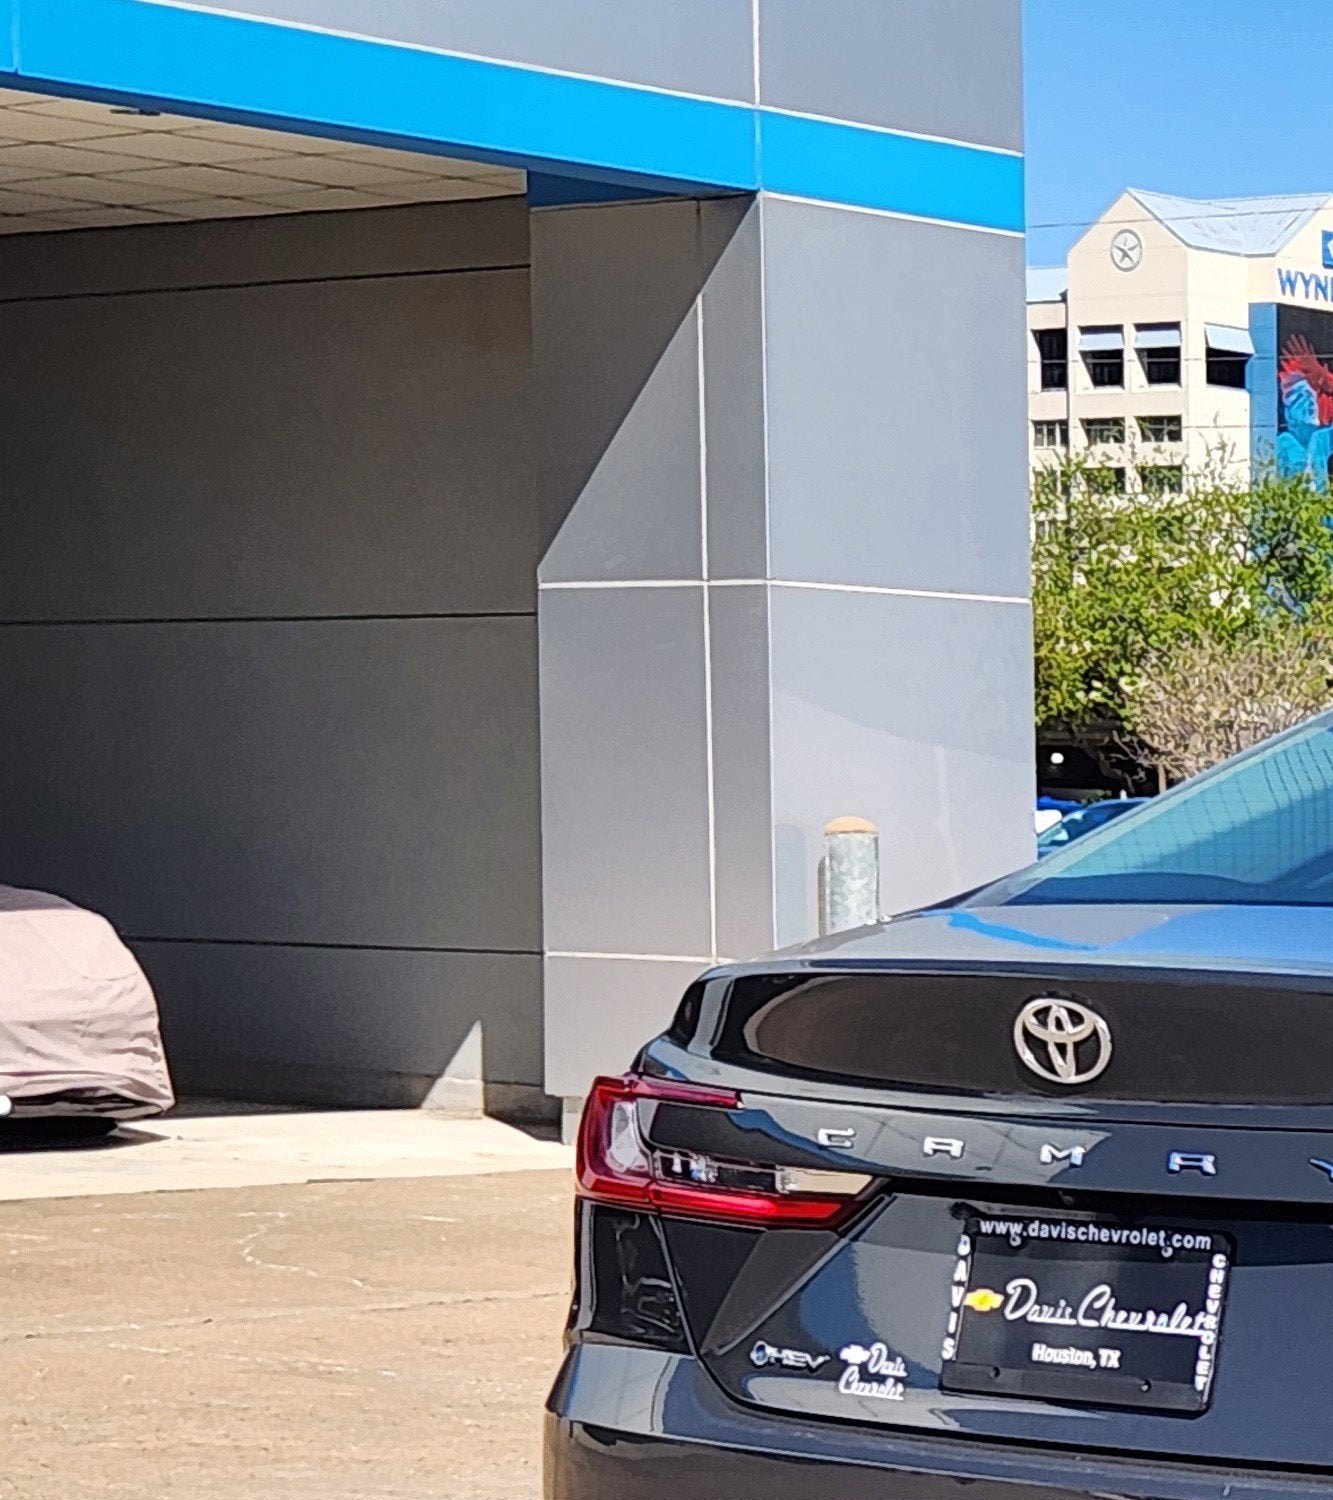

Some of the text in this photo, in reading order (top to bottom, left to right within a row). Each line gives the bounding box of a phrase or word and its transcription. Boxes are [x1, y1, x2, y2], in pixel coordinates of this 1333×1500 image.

[980, 1220, 1212, 1250] www.davischevrolet.com
[942, 1234, 971, 1360] DAVIS
[1004, 1278, 1206, 1336] Davis Chevrolet
[1032, 1343, 1122, 1369] Houston, TX
